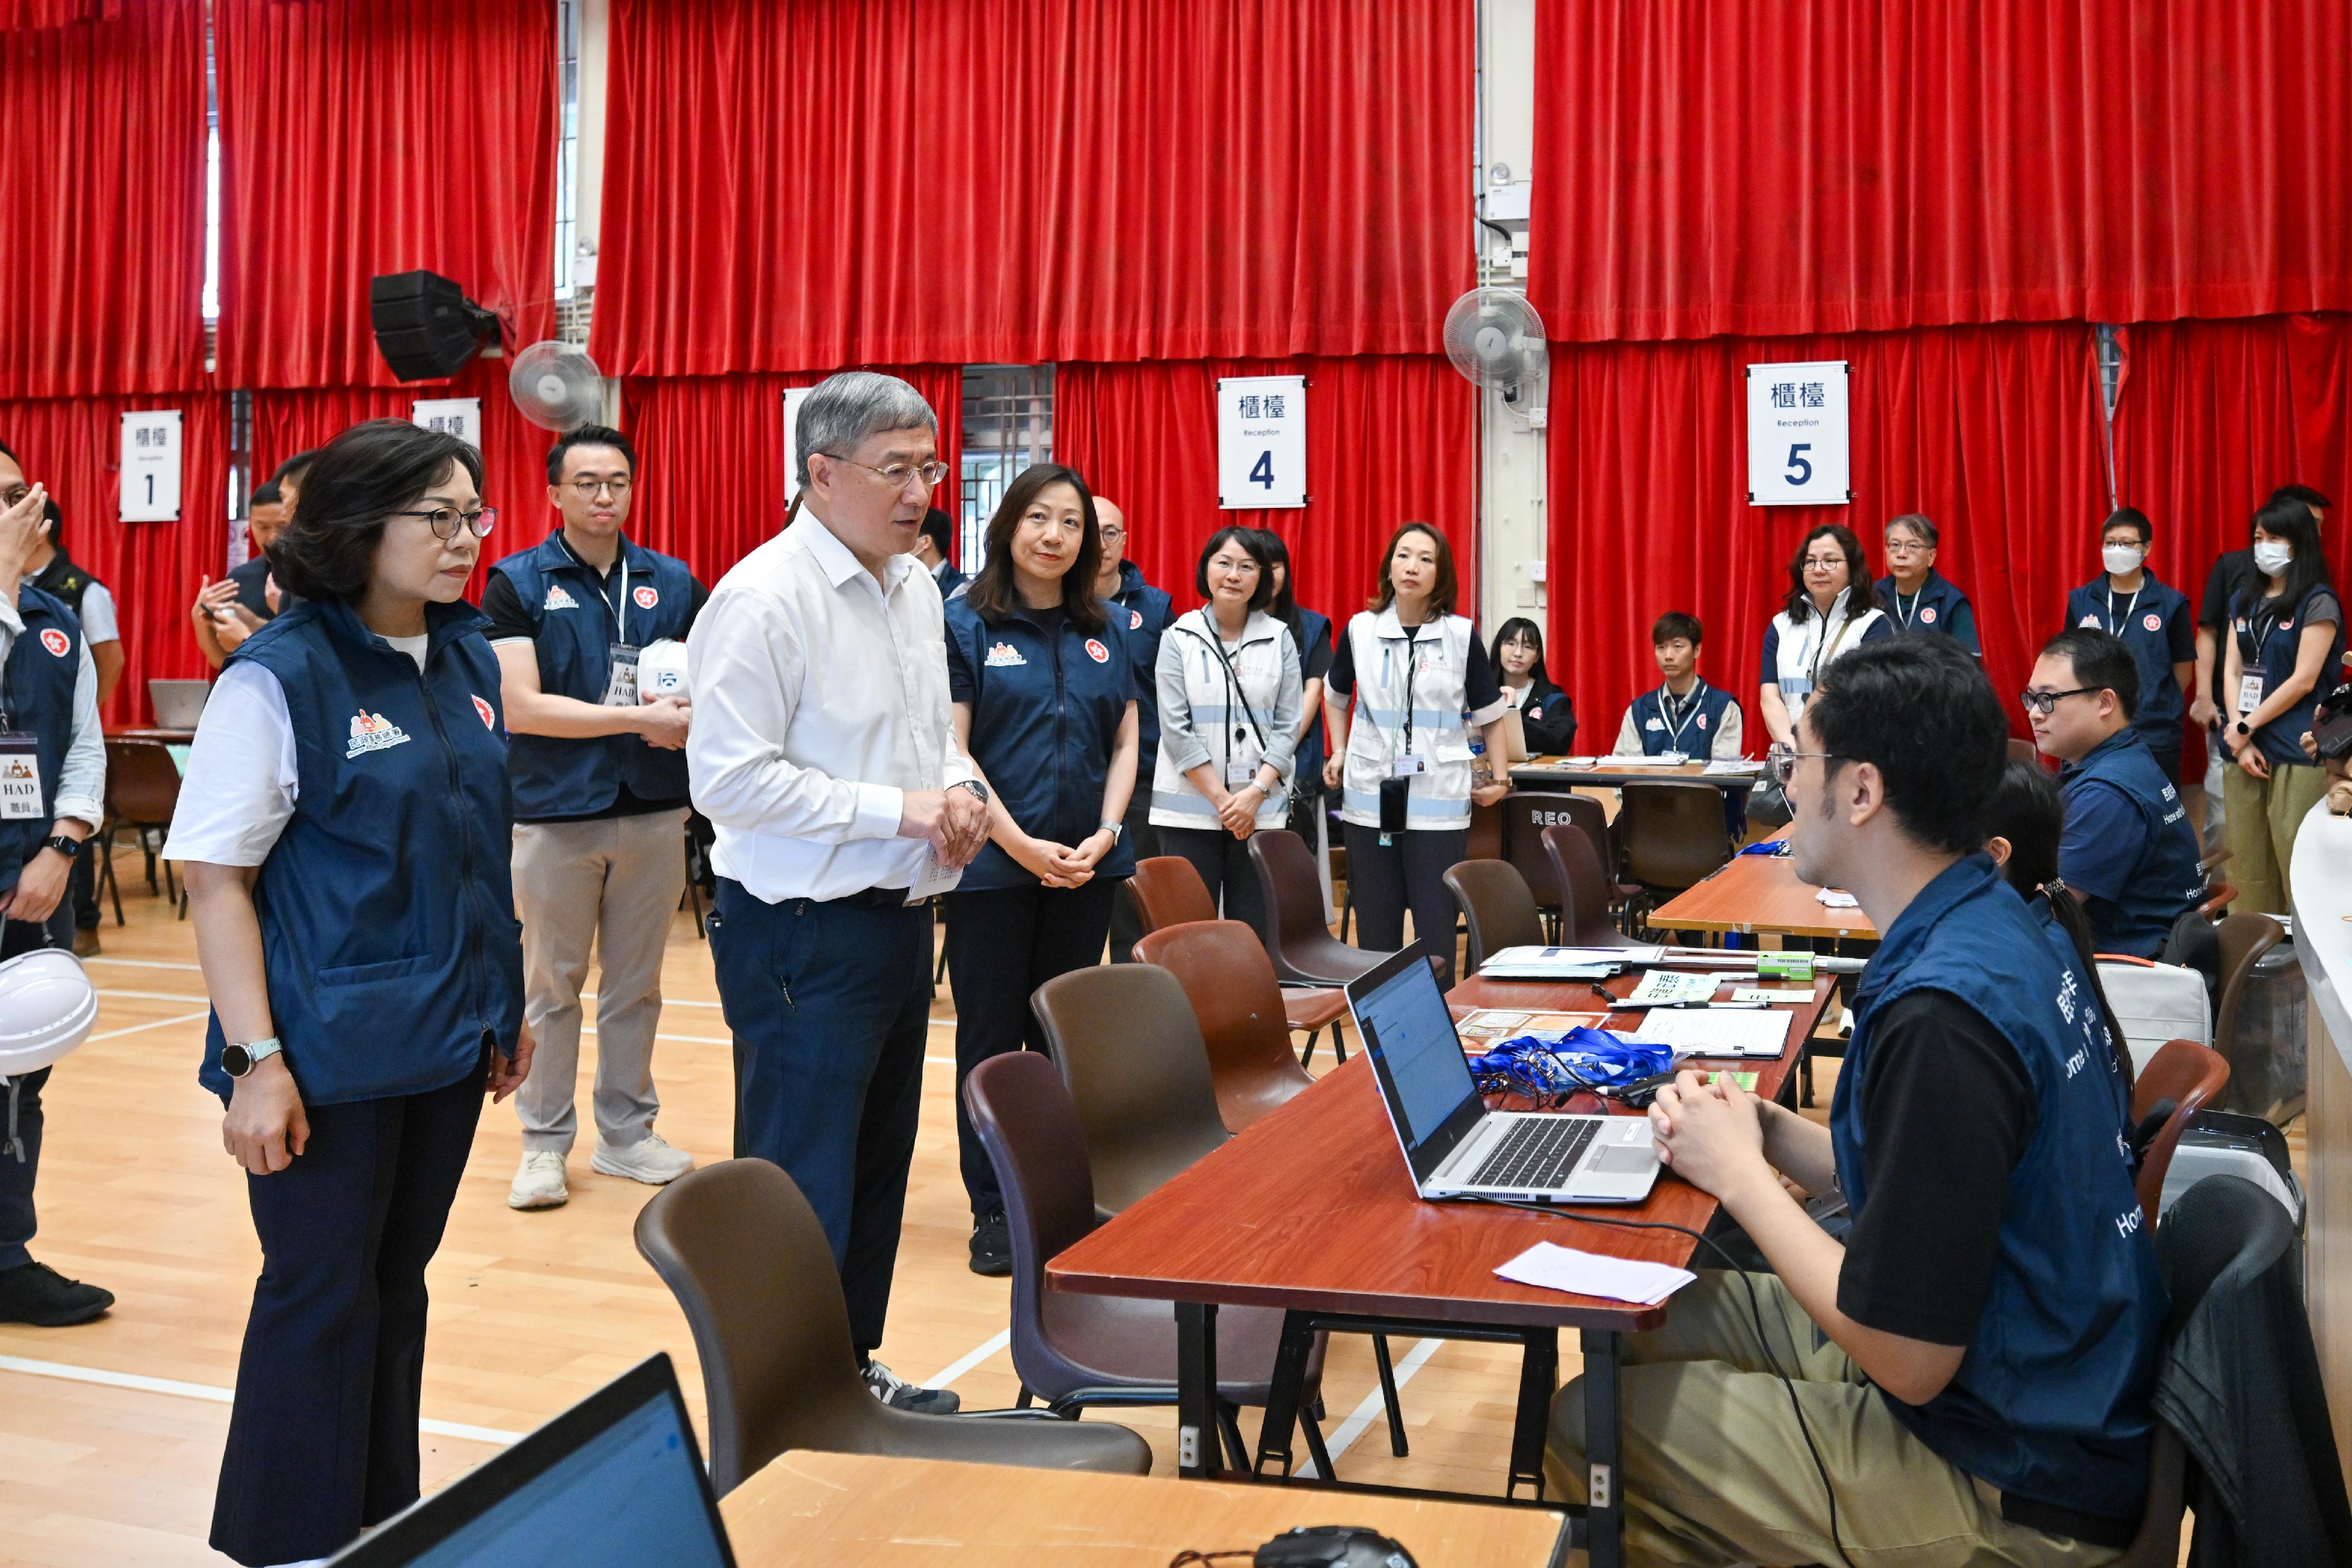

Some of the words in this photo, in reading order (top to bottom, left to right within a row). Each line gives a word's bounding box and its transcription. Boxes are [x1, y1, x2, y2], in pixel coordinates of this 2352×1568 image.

[1239, 395, 1285, 419] 櫃檯
[1772, 382, 1825, 408] 櫃檯
[1778, 419, 1819, 427] Reception
[1250, 450, 1275, 490] 4
[1784, 443, 1812, 486] 5
[145, 474, 153, 506] 1
[614, 686, 635, 697] HAD
[4, 784, 35, 795] HAD
[1532, 809, 1572, 826] REO
